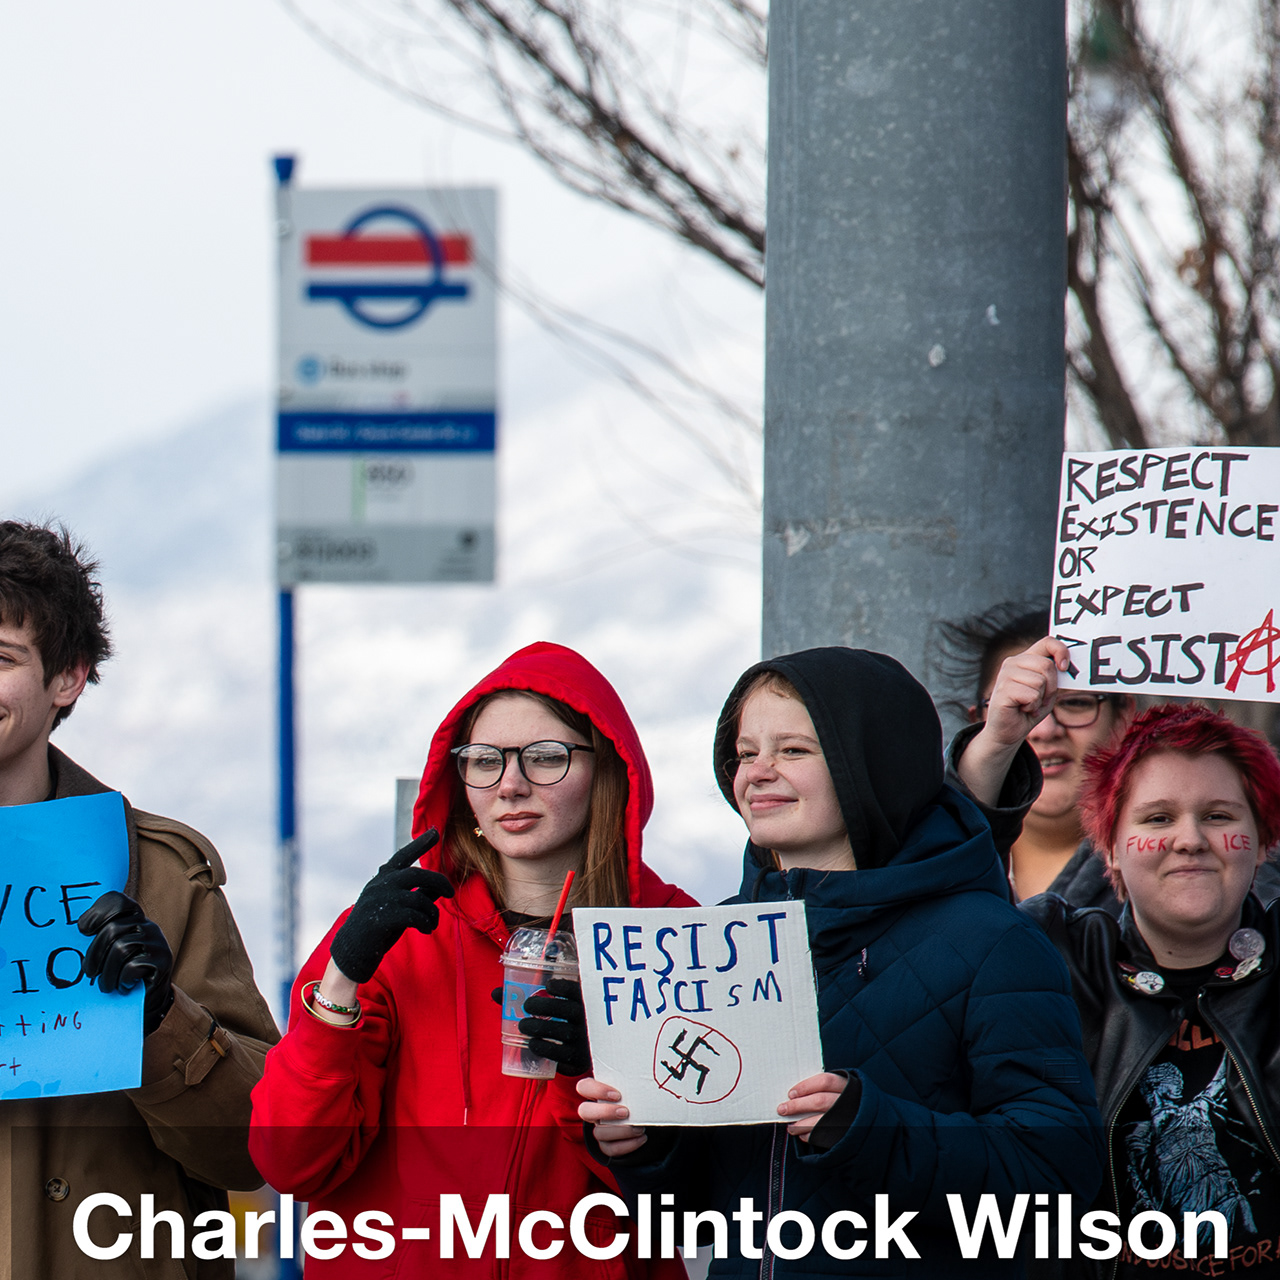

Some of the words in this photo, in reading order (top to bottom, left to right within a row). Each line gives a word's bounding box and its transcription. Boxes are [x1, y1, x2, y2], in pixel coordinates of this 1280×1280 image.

[1067, 452, 1250, 504] RESPECT
[1059, 546, 1098, 578] OR
[1054, 583, 1204, 626] EXPECT
[1126, 835, 1168, 854] FUCK
[1223, 833, 1252, 852] ICE
[592, 912, 787, 977] RESIST
[1230, 1239, 1273, 1271] FOR
